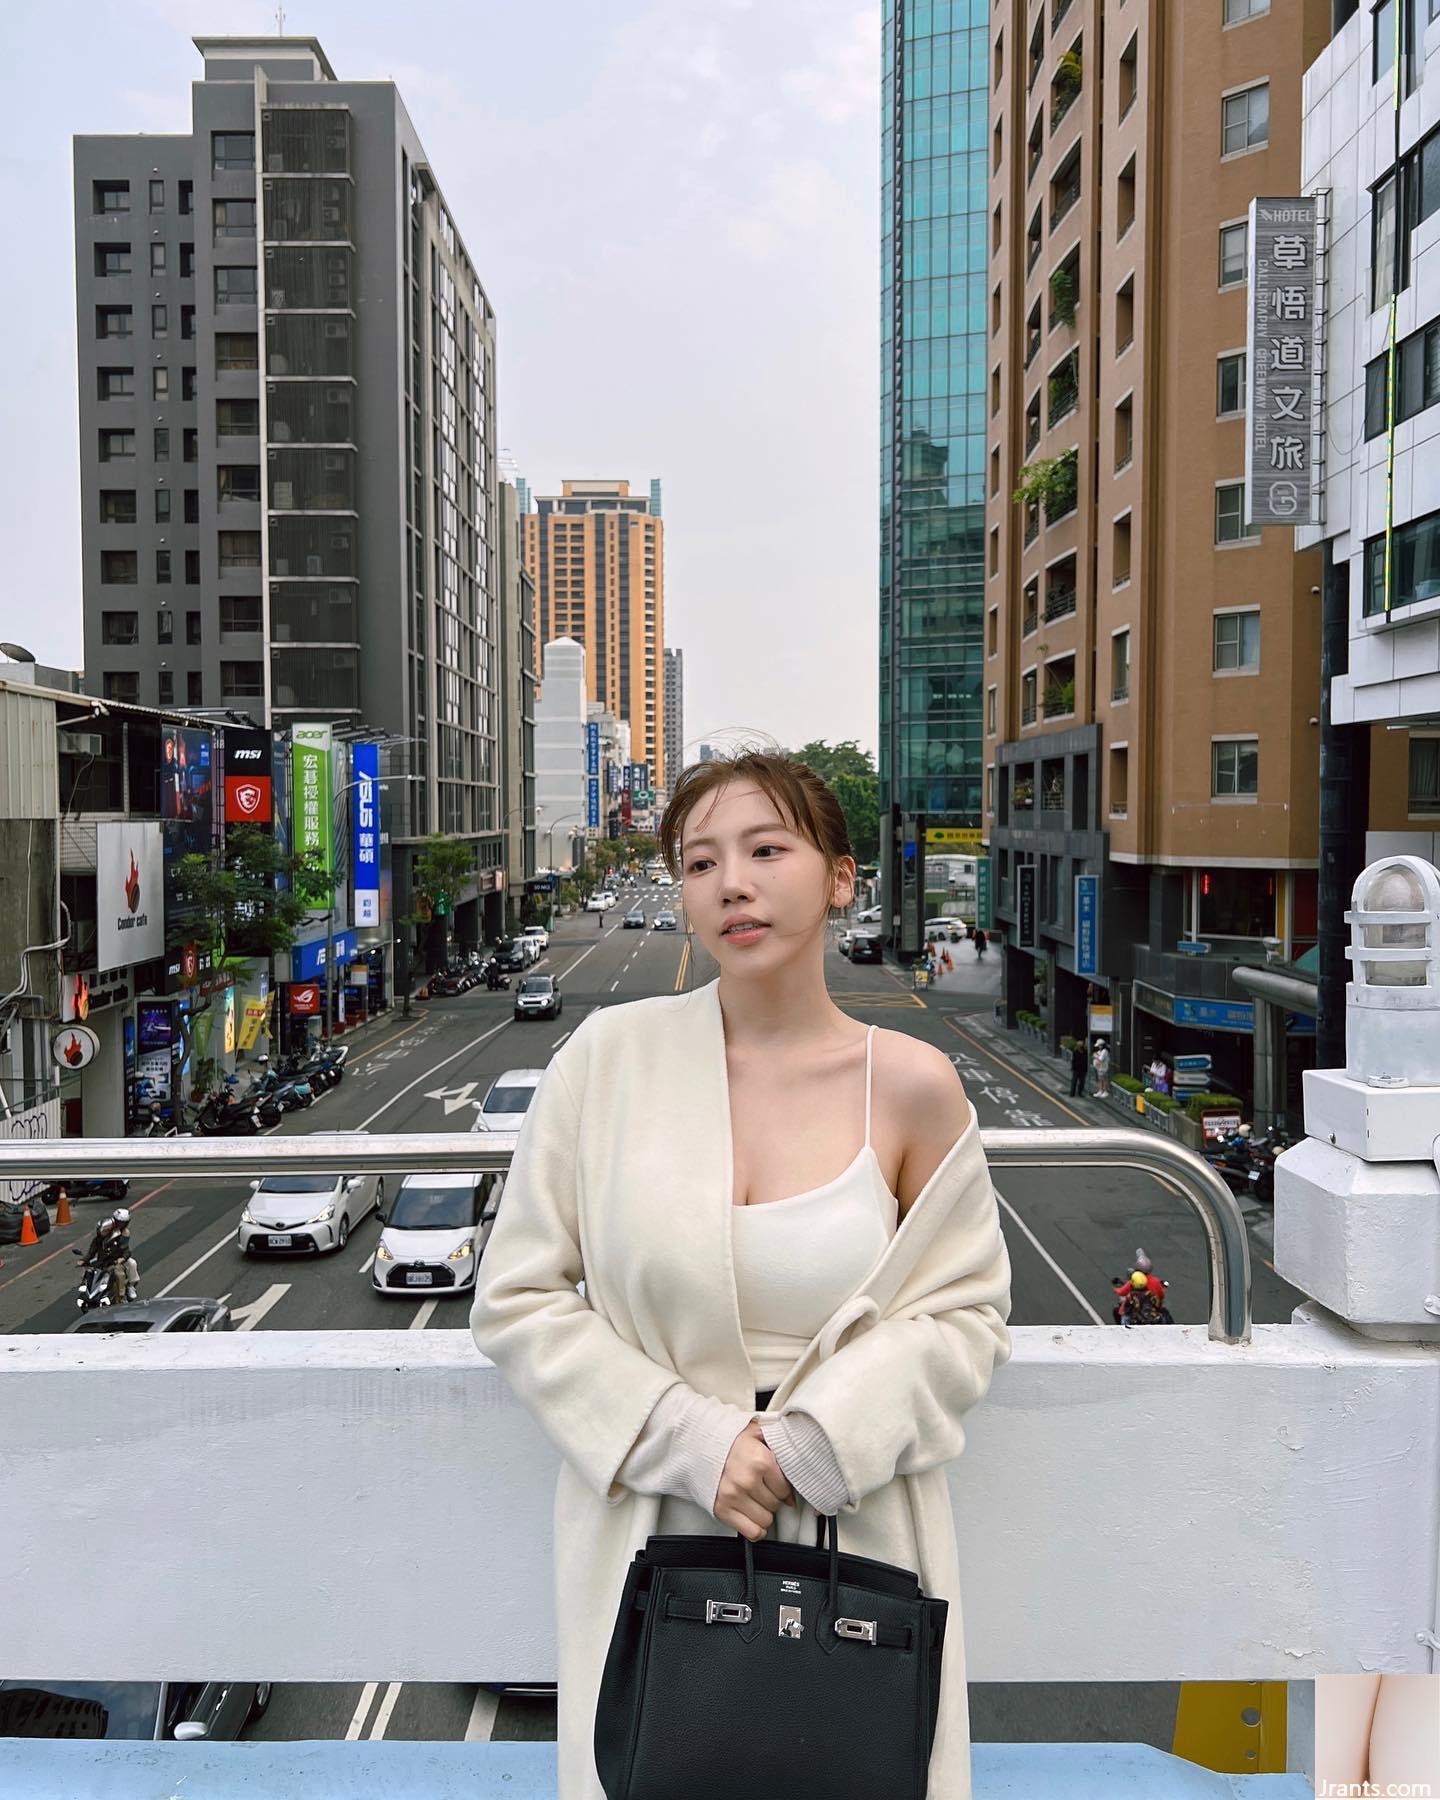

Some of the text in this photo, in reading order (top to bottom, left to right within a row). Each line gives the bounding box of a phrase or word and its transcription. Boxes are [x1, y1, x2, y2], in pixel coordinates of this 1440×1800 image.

[1273, 209, 1313, 222] HOTEL
[1269, 235, 1308, 470] 草悟道文旅
[1255, 347, 1268, 409] GREENWAY
[1255, 416, 1267, 450] HOTEL
[295, 730, 329, 739] acer
[234, 749, 263, 759] msi
